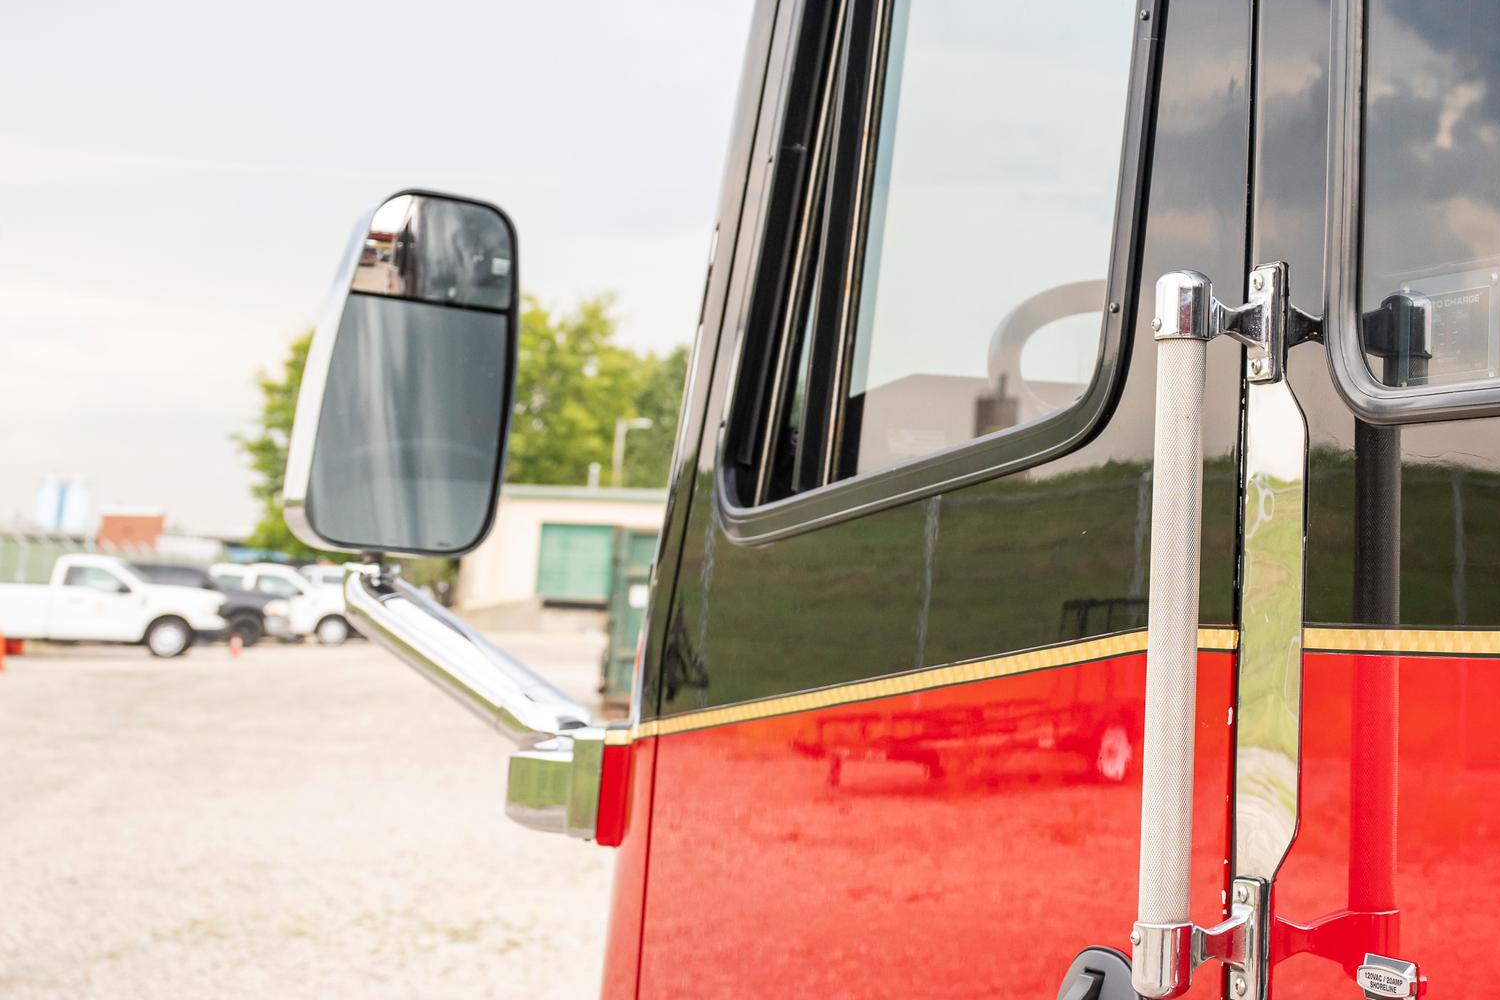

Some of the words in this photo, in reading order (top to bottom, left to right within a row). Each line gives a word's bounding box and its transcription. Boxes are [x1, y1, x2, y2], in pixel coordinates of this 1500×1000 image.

[1364, 972, 1382, 982] 120VAC
[1386, 977, 1403, 986] 20AMP
[1370, 981, 1397, 993] SHORELINE
